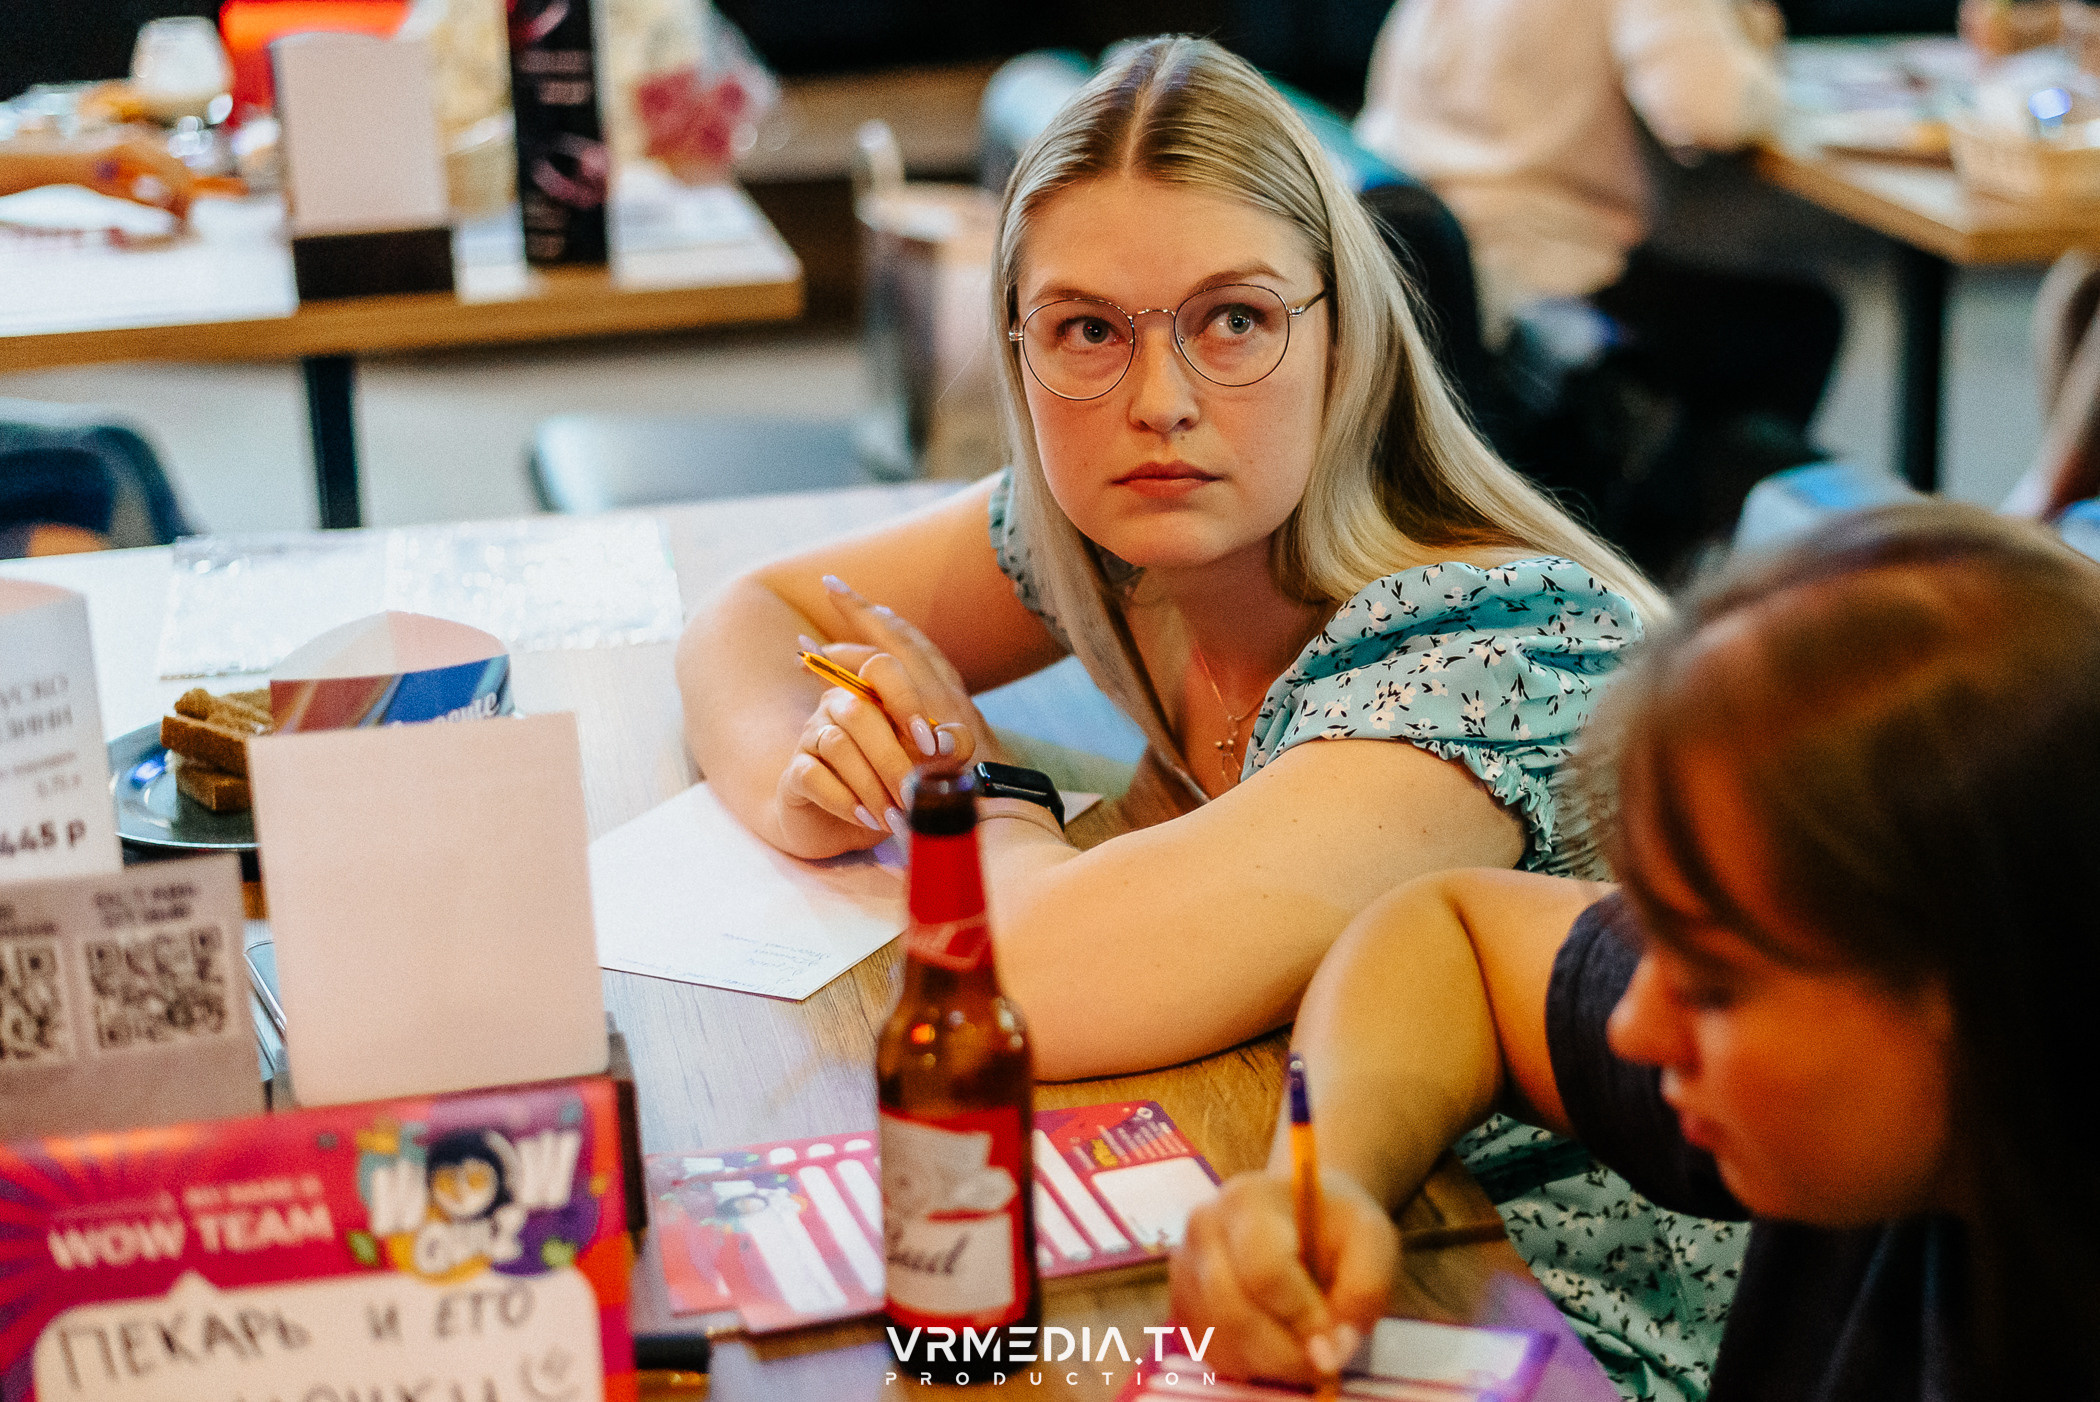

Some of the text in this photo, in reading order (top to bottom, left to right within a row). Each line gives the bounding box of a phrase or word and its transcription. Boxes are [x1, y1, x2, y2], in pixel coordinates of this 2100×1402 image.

[46, 1216, 187, 1271] WOW
[194, 1202, 335, 1256] TEAM
[56, 1306, 312, 1394] ПЕКАРЬ
[433, 1276, 535, 1341] ЕГО
